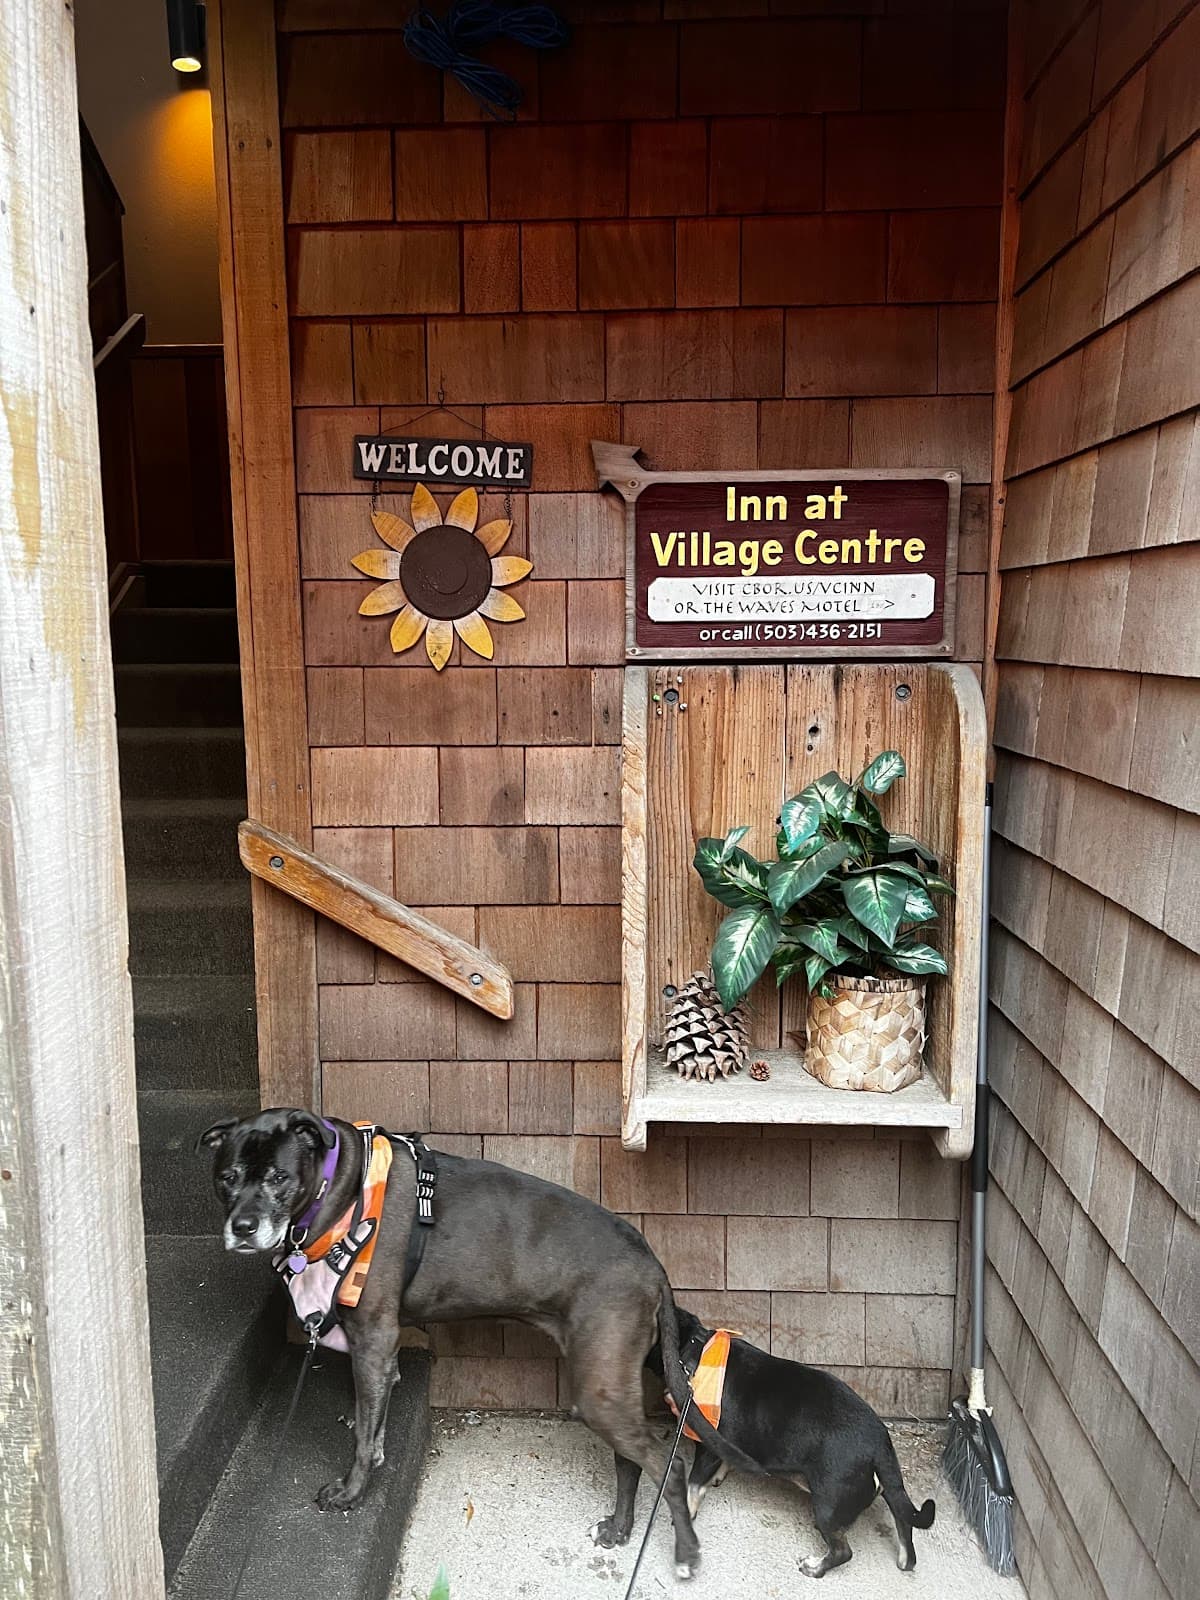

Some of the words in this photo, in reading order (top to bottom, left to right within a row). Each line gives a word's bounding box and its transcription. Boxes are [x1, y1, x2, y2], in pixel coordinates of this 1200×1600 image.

[358, 442, 525, 479] WELCOME
[726, 486, 788, 521] Inn
[803, 485, 848, 520] at
[650, 531, 784, 576] Village
[794, 529, 926, 565] Centre
[674, 601, 699, 614] OR
[703, 601, 733, 614] THE
[738, 600, 795, 613] WAVES
[801, 599, 861, 613] MOTEL
[692, 582, 736, 596] VISIT
